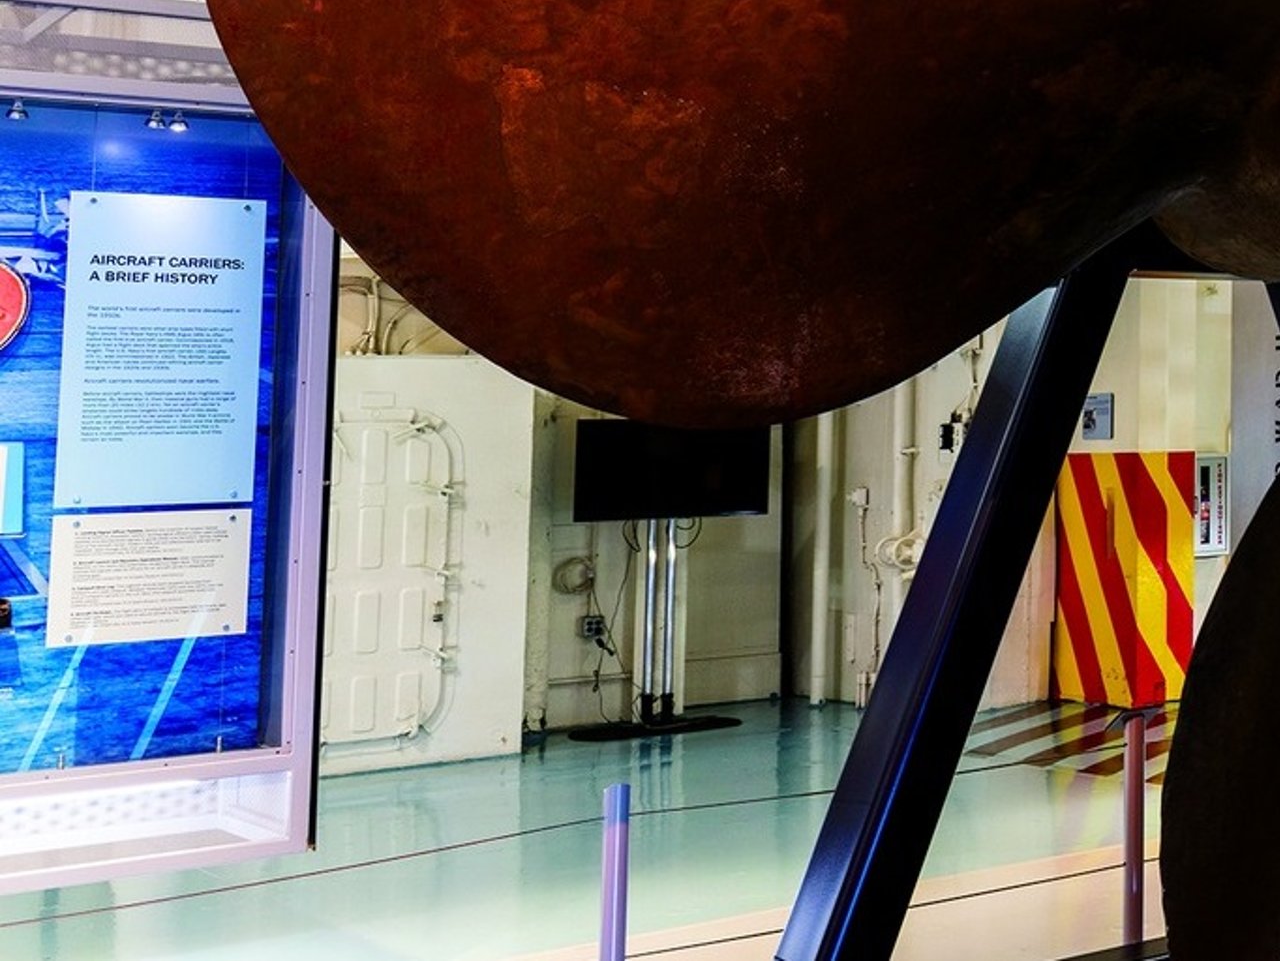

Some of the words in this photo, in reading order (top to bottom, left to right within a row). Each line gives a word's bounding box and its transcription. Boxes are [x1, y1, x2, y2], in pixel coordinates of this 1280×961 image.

[90, 254, 165, 267] AIRCRAFT
[168, 257, 245, 270] CARRIERS:
[89, 270, 100, 281] A
[105, 271, 150, 283] BRIEF
[154, 272, 219, 285] HISTORY
